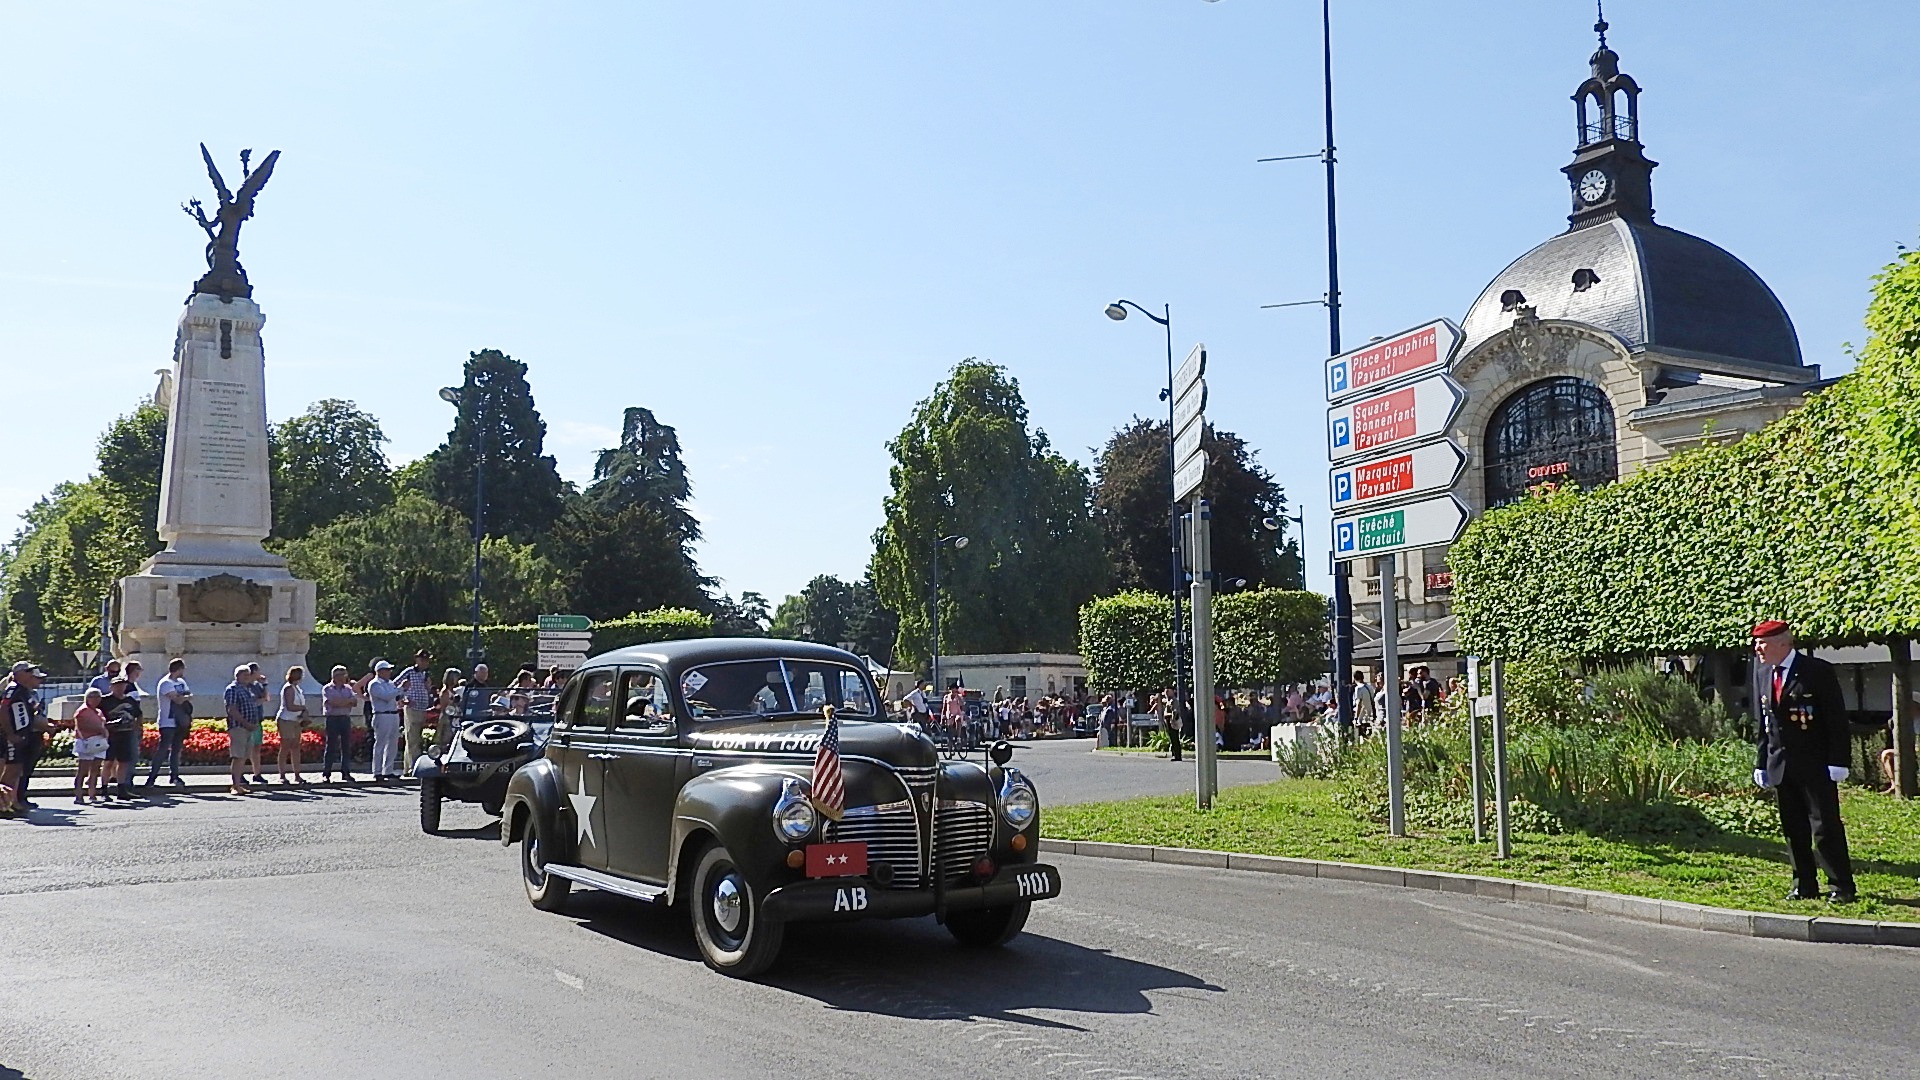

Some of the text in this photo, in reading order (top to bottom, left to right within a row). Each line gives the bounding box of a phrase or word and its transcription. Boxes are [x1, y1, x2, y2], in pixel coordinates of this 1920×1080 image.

[1353, 333, 1435, 371] Place Dauphine
[1333, 366, 1344, 391] P
[1353, 359, 1395, 386] (Payant)
[1355, 400, 1390, 420] Square
[1355, 406, 1415, 434] Bonnenfant
[1335, 421, 1346, 445] P
[1356, 424, 1398, 450] (Payant)
[1357, 460, 1412, 483] Marquigny
[1528, 462, 1569, 478] OUVERT
[1337, 476, 1349, 500] P
[1357, 475, 1400, 499] (Payant)
[1340, 526, 1351, 550] P
[1361, 527, 1405, 550] (Gratuit)
[834, 887, 868, 912] AB
